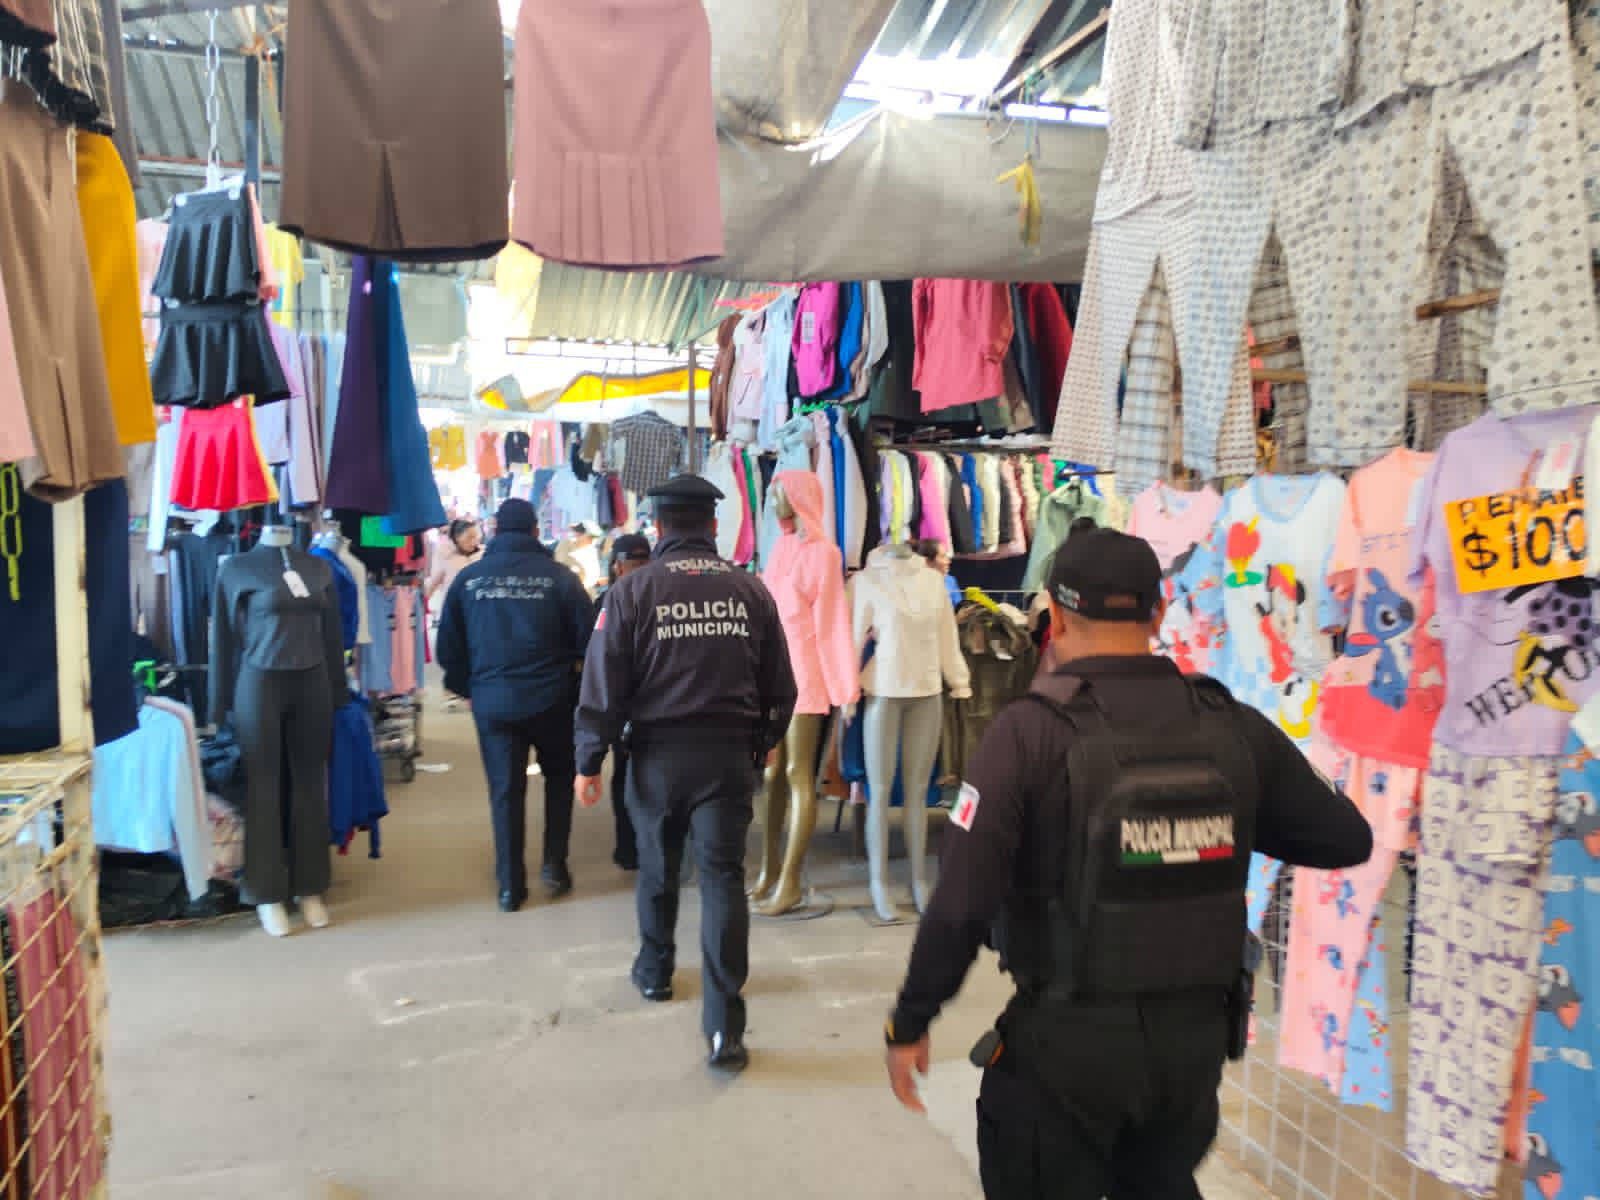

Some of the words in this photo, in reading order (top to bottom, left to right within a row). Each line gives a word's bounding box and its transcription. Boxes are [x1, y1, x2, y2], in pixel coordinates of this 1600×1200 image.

[1461, 507, 1587, 578] $100
[655, 597, 749, 623] POLICÍA
[656, 621, 750, 641] MUNICIPAL
